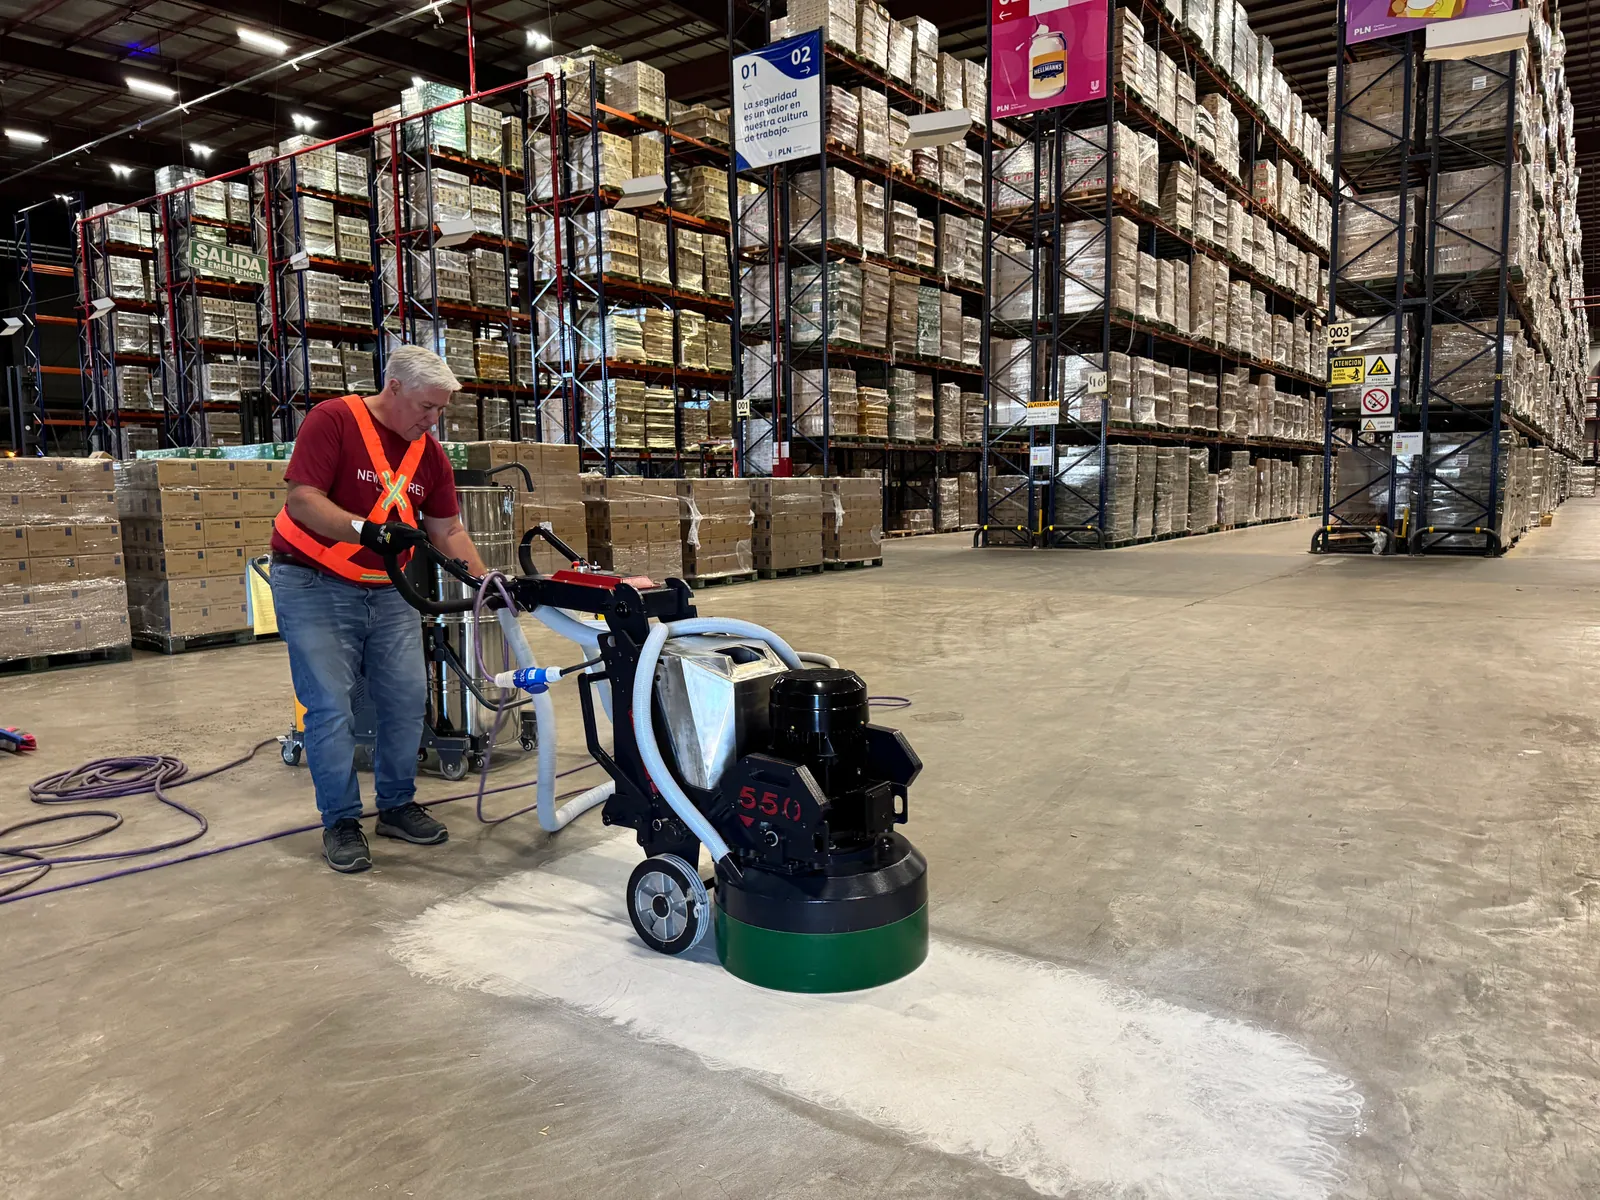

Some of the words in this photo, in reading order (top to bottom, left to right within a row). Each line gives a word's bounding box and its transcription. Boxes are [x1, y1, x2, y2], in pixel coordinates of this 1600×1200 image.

[1354, 25, 1372, 36] PLN
[791, 46, 811, 65] 02
[741, 62, 758, 80] 01
[743, 102, 753, 110] La
[754, 89, 797, 107] seguridad
[996, 104, 1010, 112] PLN
[754, 110, 765, 118] un
[767, 105, 788, 115] valor
[790, 100, 801, 109] en
[744, 119, 776, 132] nuestra
[777, 110, 808, 124] cultura
[744, 133, 755, 143] de
[756, 126, 790, 139] trabajo.
[778, 146, 792, 156] PLN
[196, 243, 262, 273] SALIDA
[193, 257, 206, 267] DE
[208, 261, 264, 281] EMERGENCIA
[1329, 326, 1350, 338] 003
[738, 402, 748, 410] 001
[740, 786, 801, 821] 550
